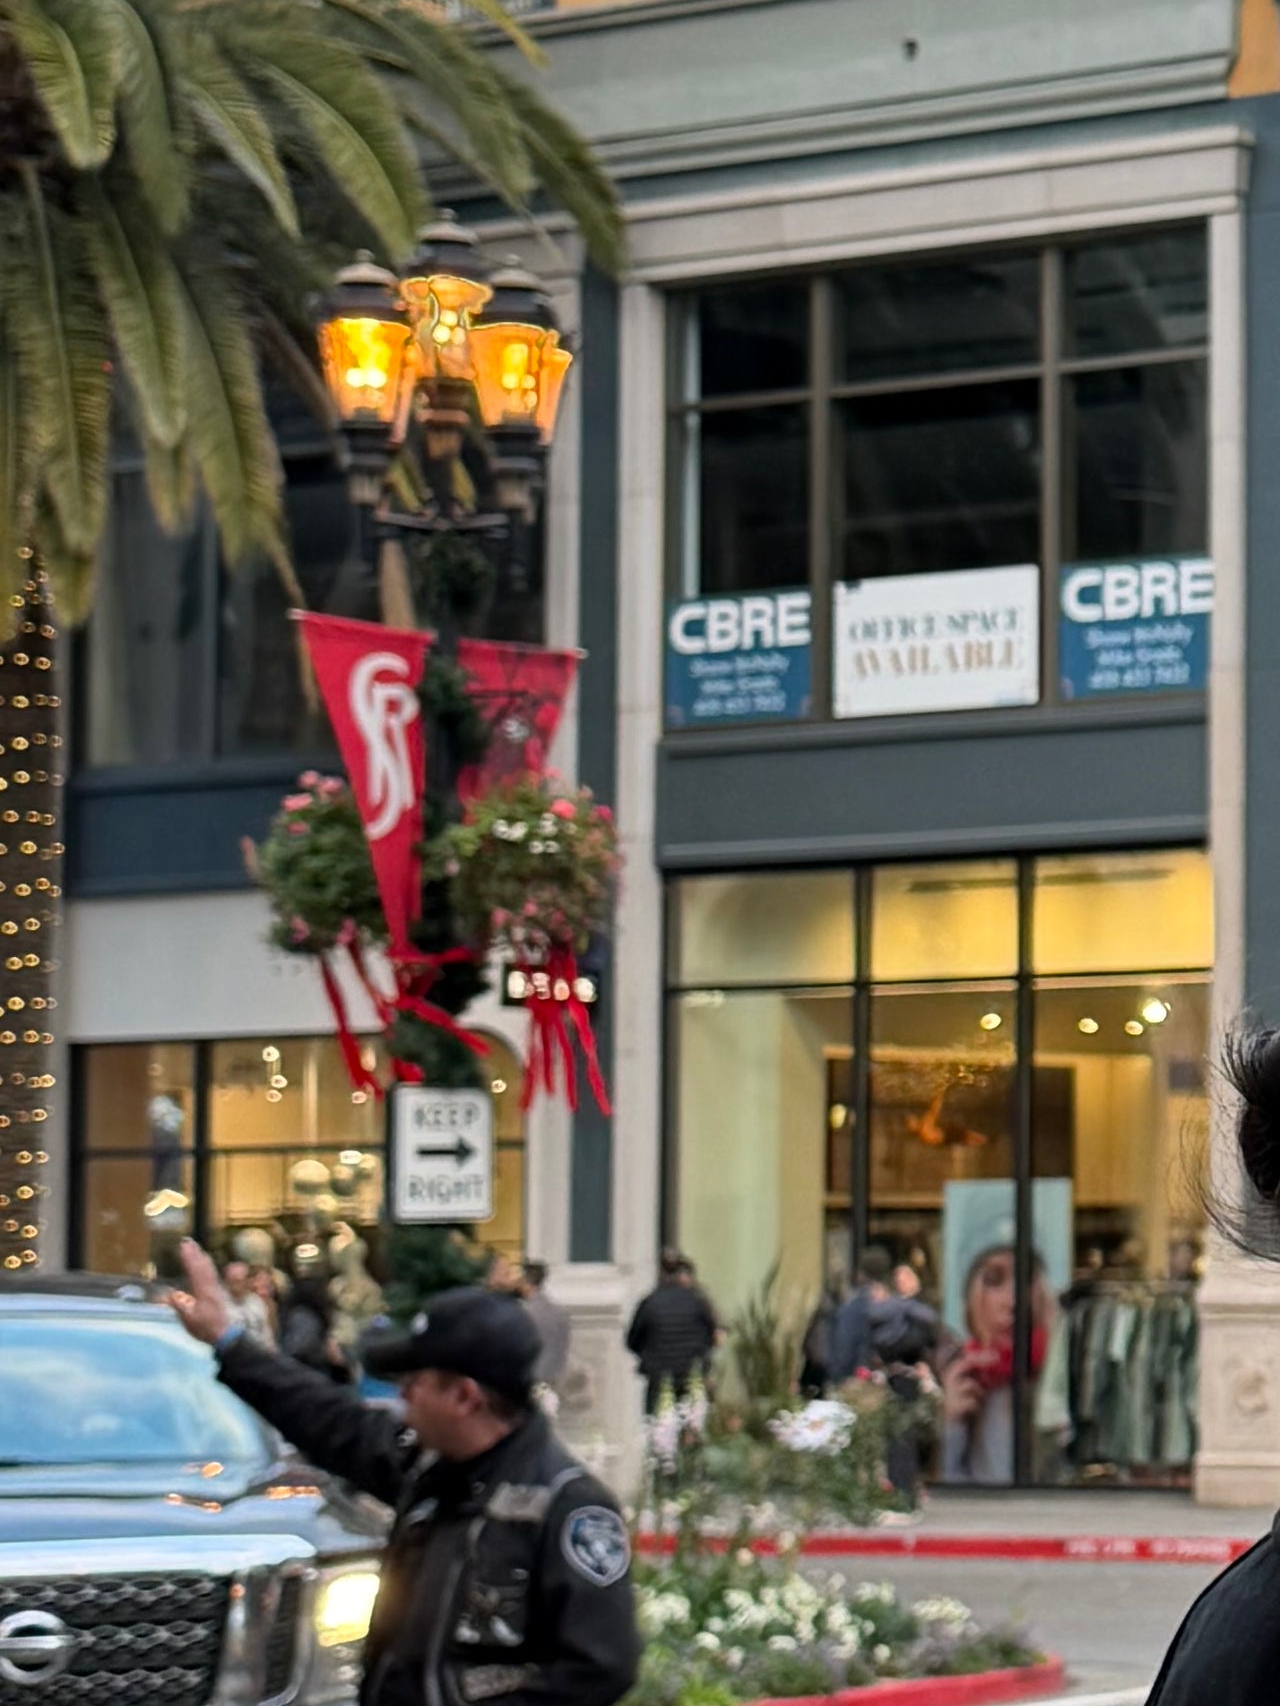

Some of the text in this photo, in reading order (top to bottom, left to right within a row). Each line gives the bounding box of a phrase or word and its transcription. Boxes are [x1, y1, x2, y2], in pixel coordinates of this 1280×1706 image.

[1062, 559, 1215, 623] CBRE
[669, 591, 811, 655] CBRE
[415, 1101, 480, 1129] KEEP
[408, 1173, 484, 1205] RIGHT
